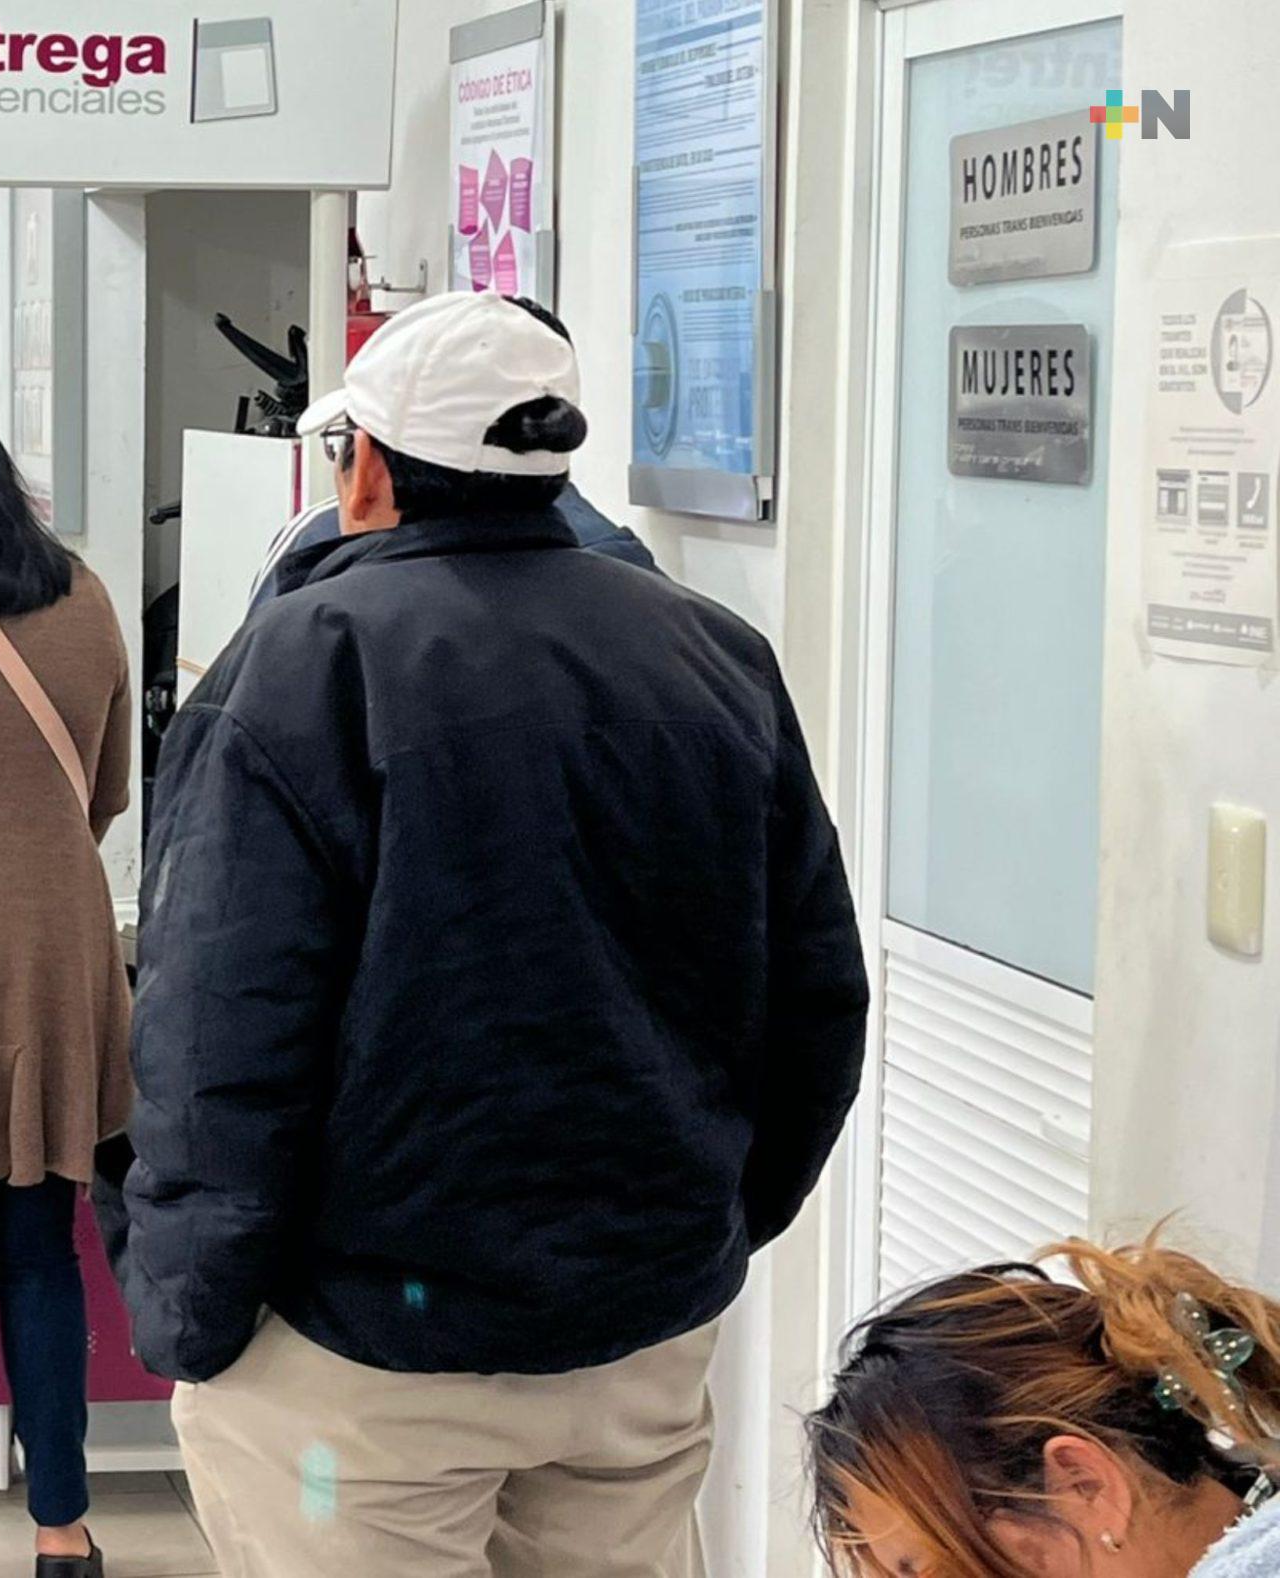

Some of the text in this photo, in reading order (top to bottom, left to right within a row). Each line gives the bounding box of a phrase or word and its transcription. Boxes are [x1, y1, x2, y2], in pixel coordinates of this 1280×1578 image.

[962, 136, 1083, 204] HOMBRES
[959, 208, 1084, 240] PERSONAS TRANS BIENVENIDAS
[961, 349, 1075, 397] MUJERES
[958, 417, 1079, 436] PERSONAS TRANS BIENVENIDAS
